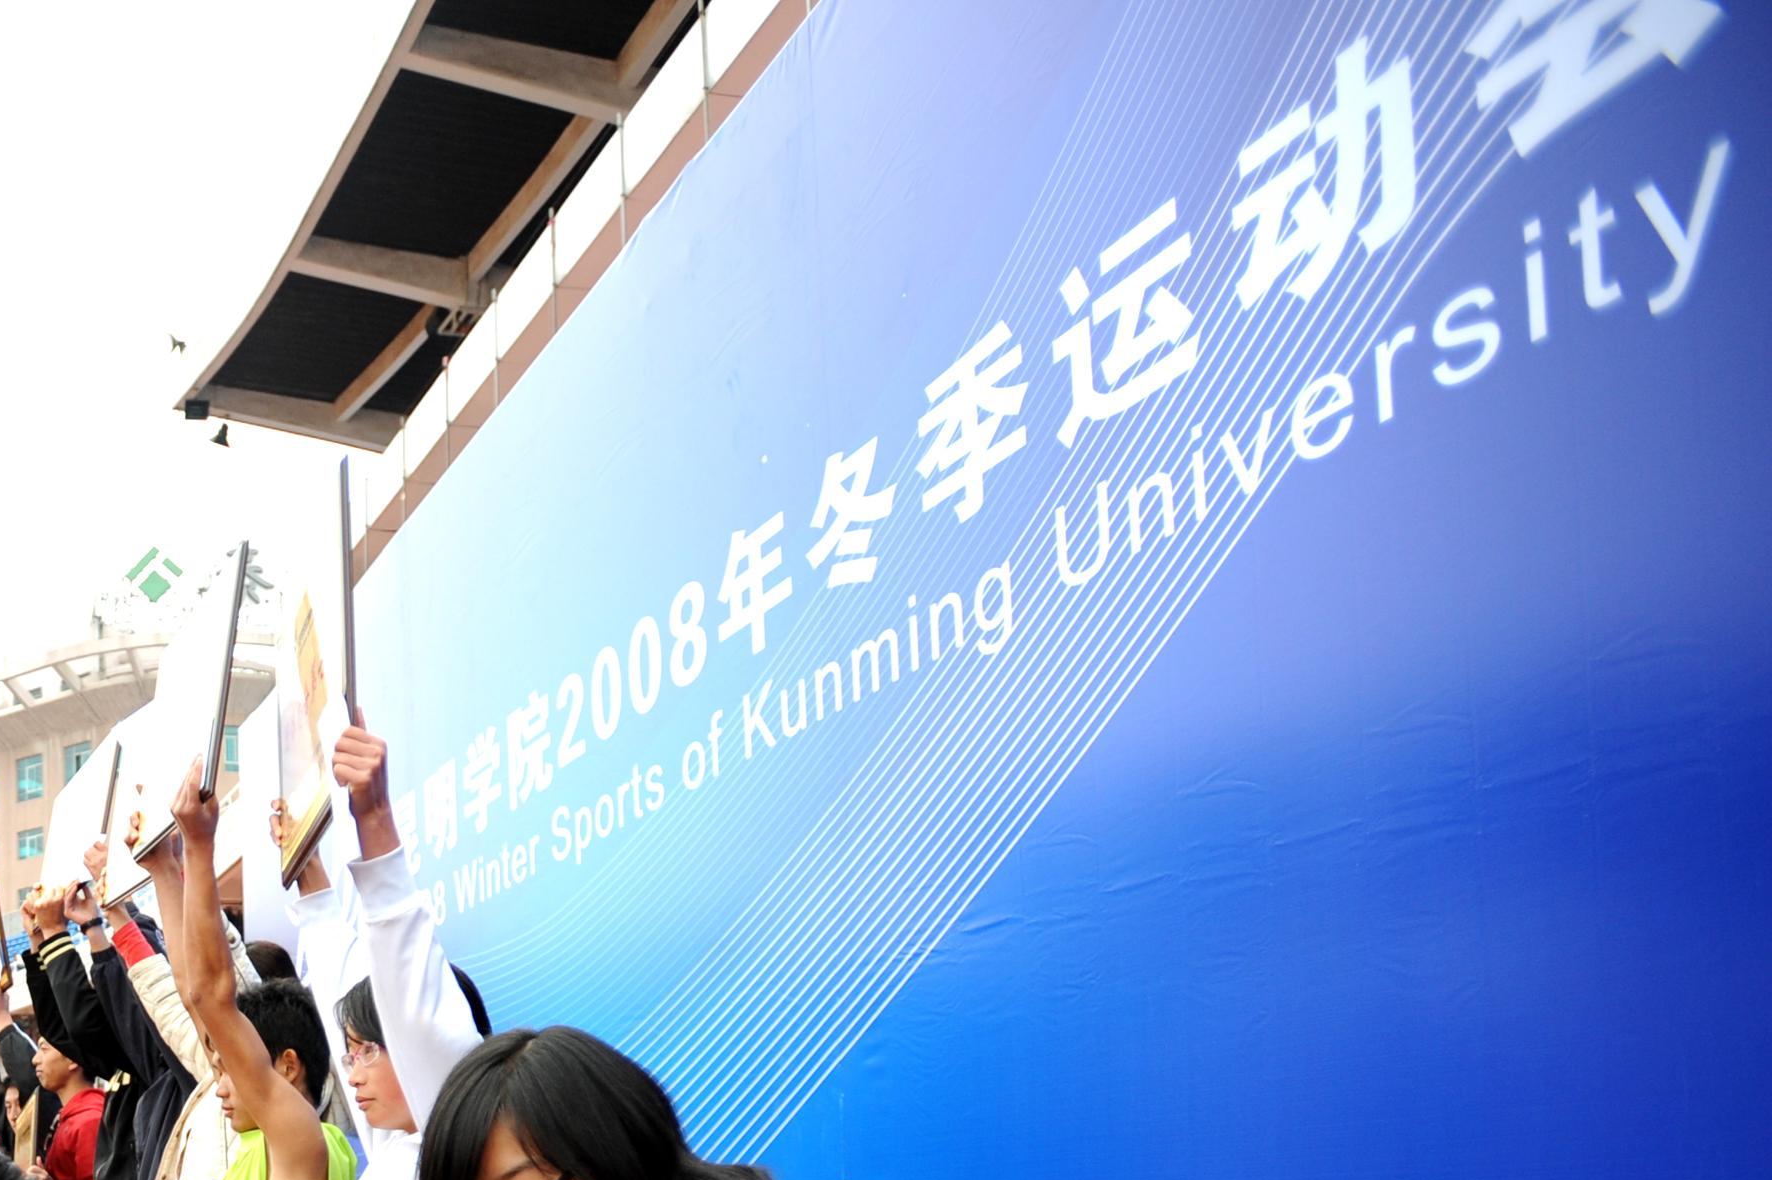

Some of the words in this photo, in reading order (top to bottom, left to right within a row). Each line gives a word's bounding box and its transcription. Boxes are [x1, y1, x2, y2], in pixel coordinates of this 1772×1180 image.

[453, 835, 540, 913] Winter
[551, 764, 665, 865] Sports
[682, 709, 724, 790] of
[742, 559, 1013, 760] Kunming
[1055, 138, 1730, 587] University
